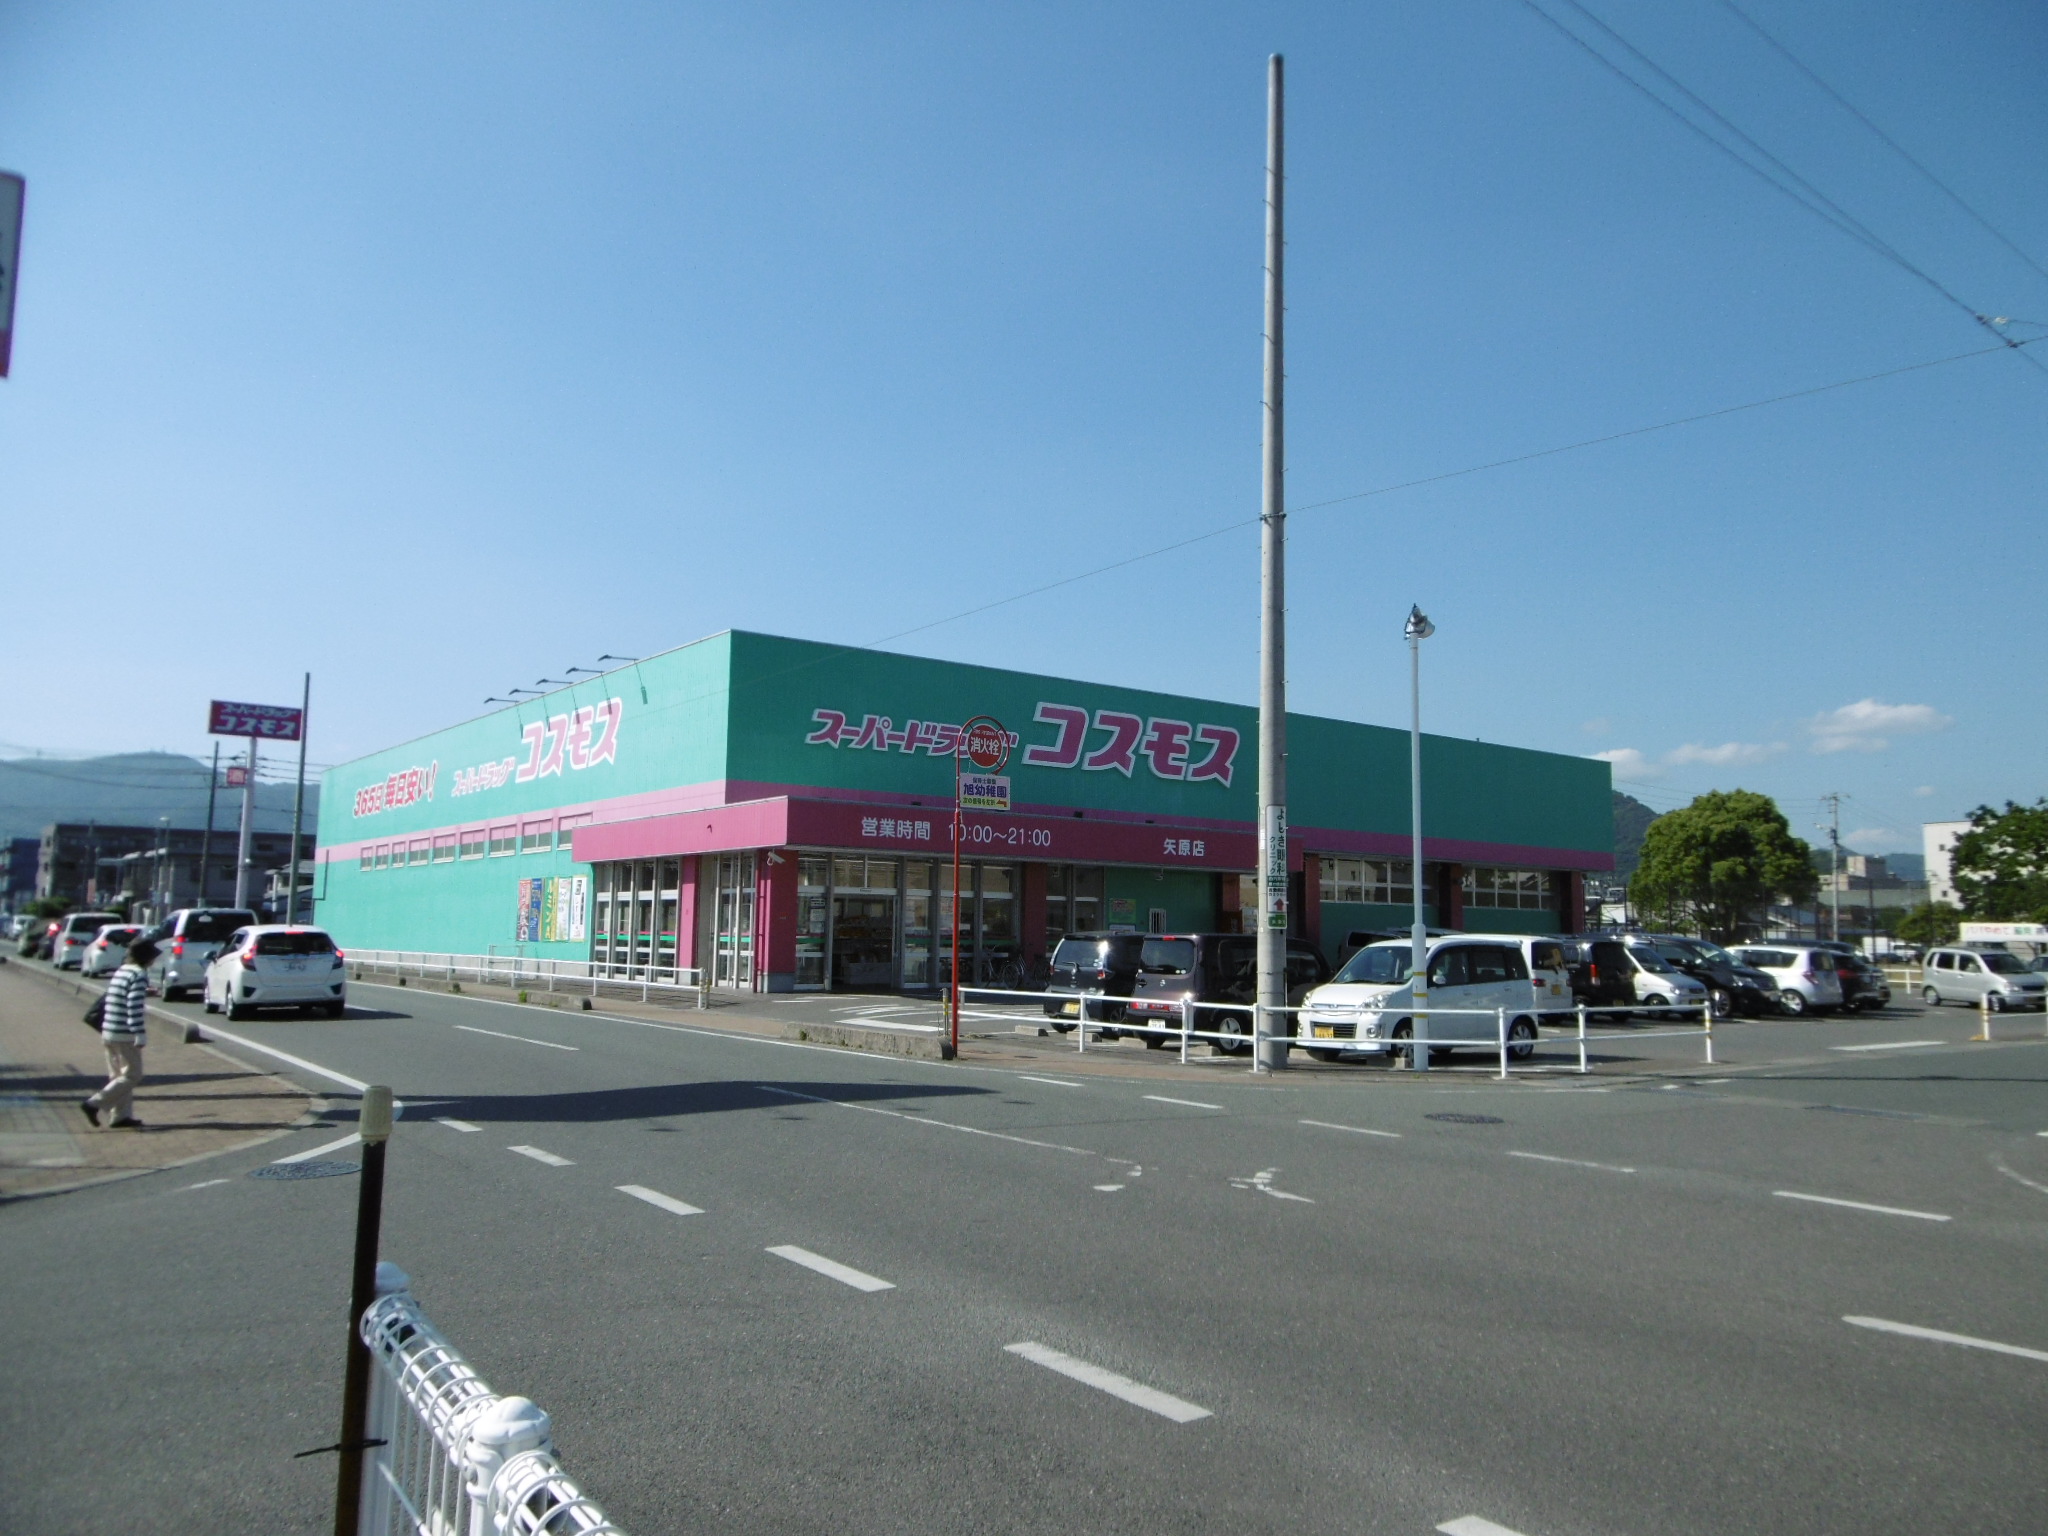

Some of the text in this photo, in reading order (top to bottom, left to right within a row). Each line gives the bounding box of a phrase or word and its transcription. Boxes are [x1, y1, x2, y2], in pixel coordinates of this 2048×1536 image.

[214, 716, 296, 736] コスモス
[515, 697, 622, 783] コスモス
[804, 701, 1240, 788] スーパードラ コスモス
[970, 736, 1000, 756] 消火栓
[963, 783, 1007, 798] 旭幼稚園
[861, 817, 931, 841] 営業時間
[1163, 838, 1205, 857] 矢原店
[1269, 836, 1277, 875] クリニック
